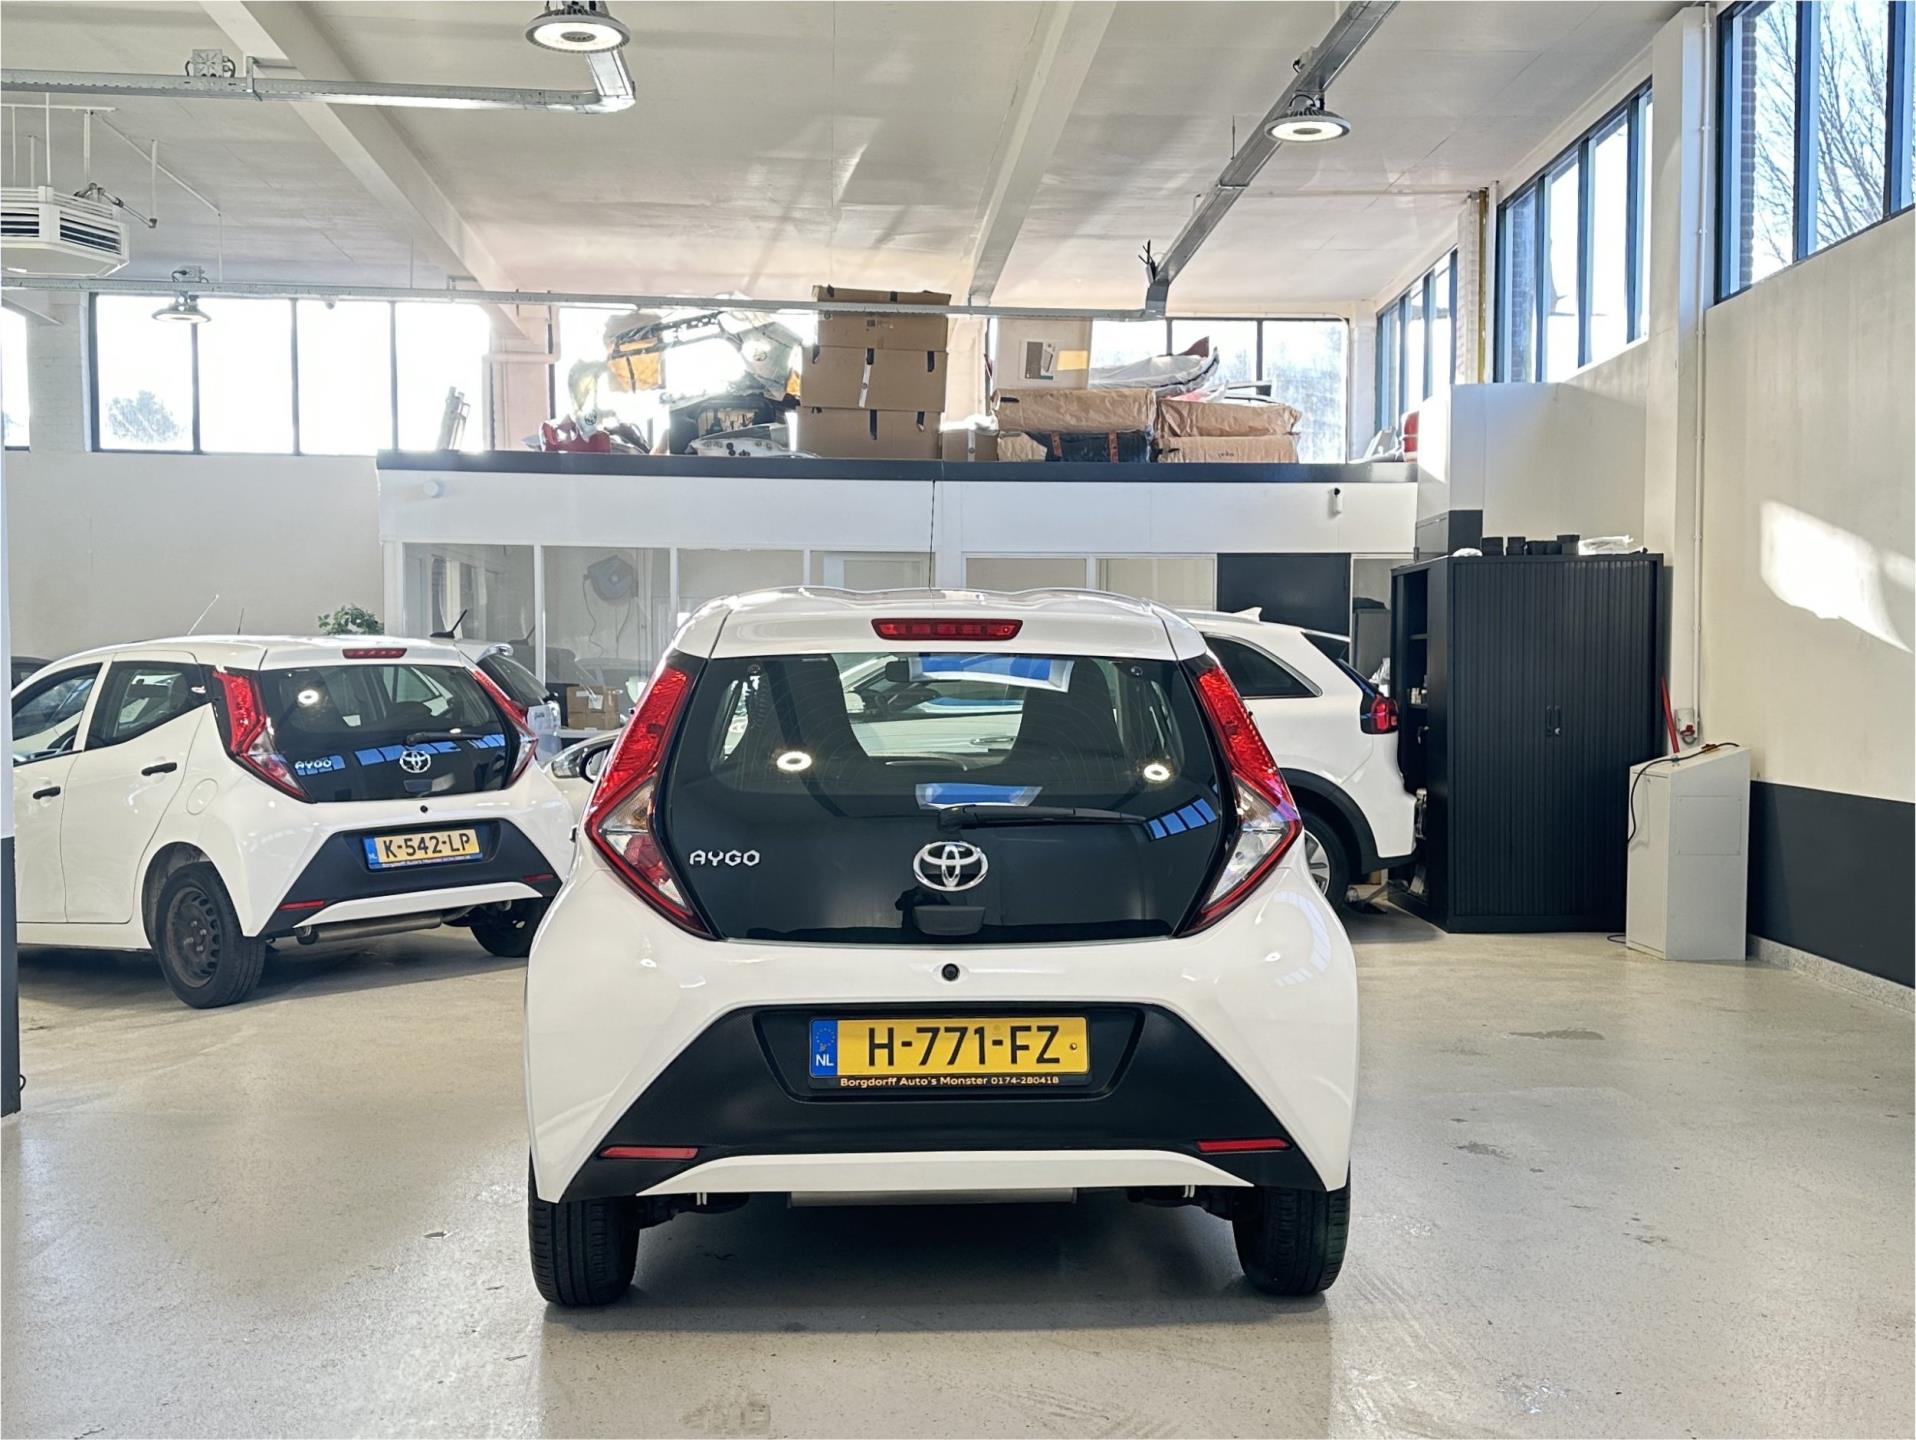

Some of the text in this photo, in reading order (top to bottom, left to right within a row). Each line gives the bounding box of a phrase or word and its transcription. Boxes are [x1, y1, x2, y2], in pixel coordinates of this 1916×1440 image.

[382, 833, 471, 859] K-542-LP
[689, 849, 761, 867] AYGO
[868, 1025, 1061, 1067] H-771-FZ
[815, 1054, 834, 1067] NL
[840, 1075, 1060, 1089] Borgdorff Auto's Monster 0174-280418
